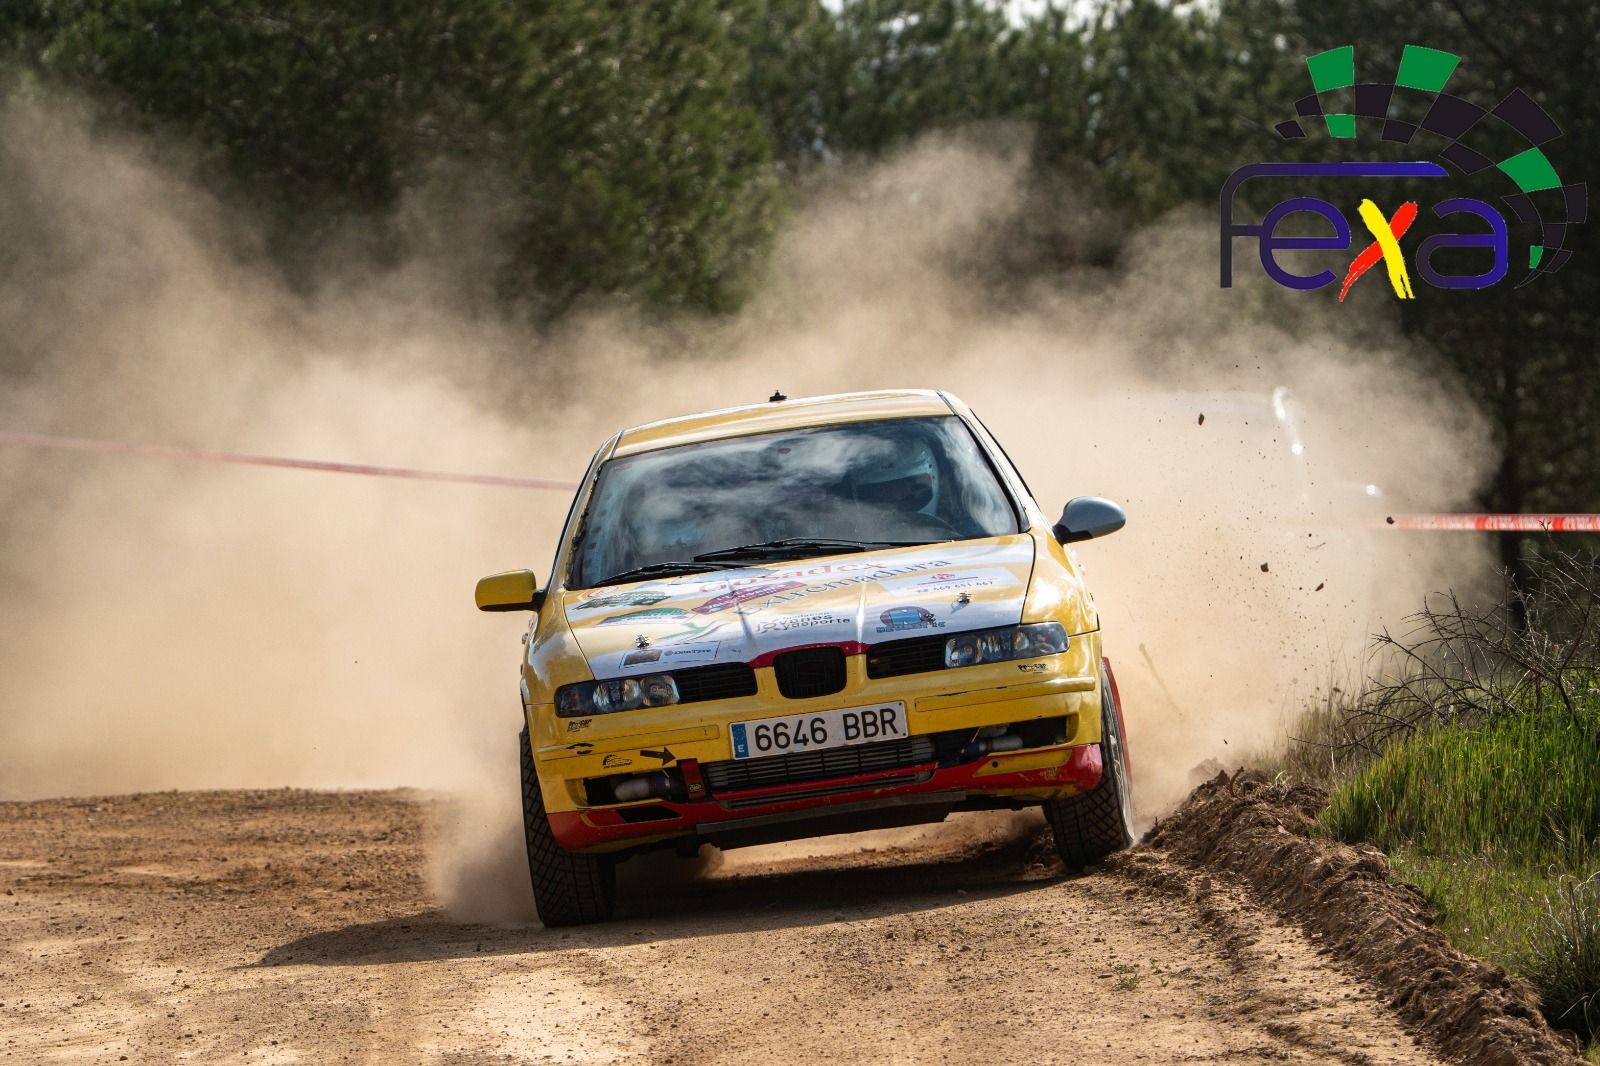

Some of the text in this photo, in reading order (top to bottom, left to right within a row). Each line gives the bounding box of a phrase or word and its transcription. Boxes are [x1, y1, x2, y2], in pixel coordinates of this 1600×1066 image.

[738, 708, 898, 753] E 6646 BBR
